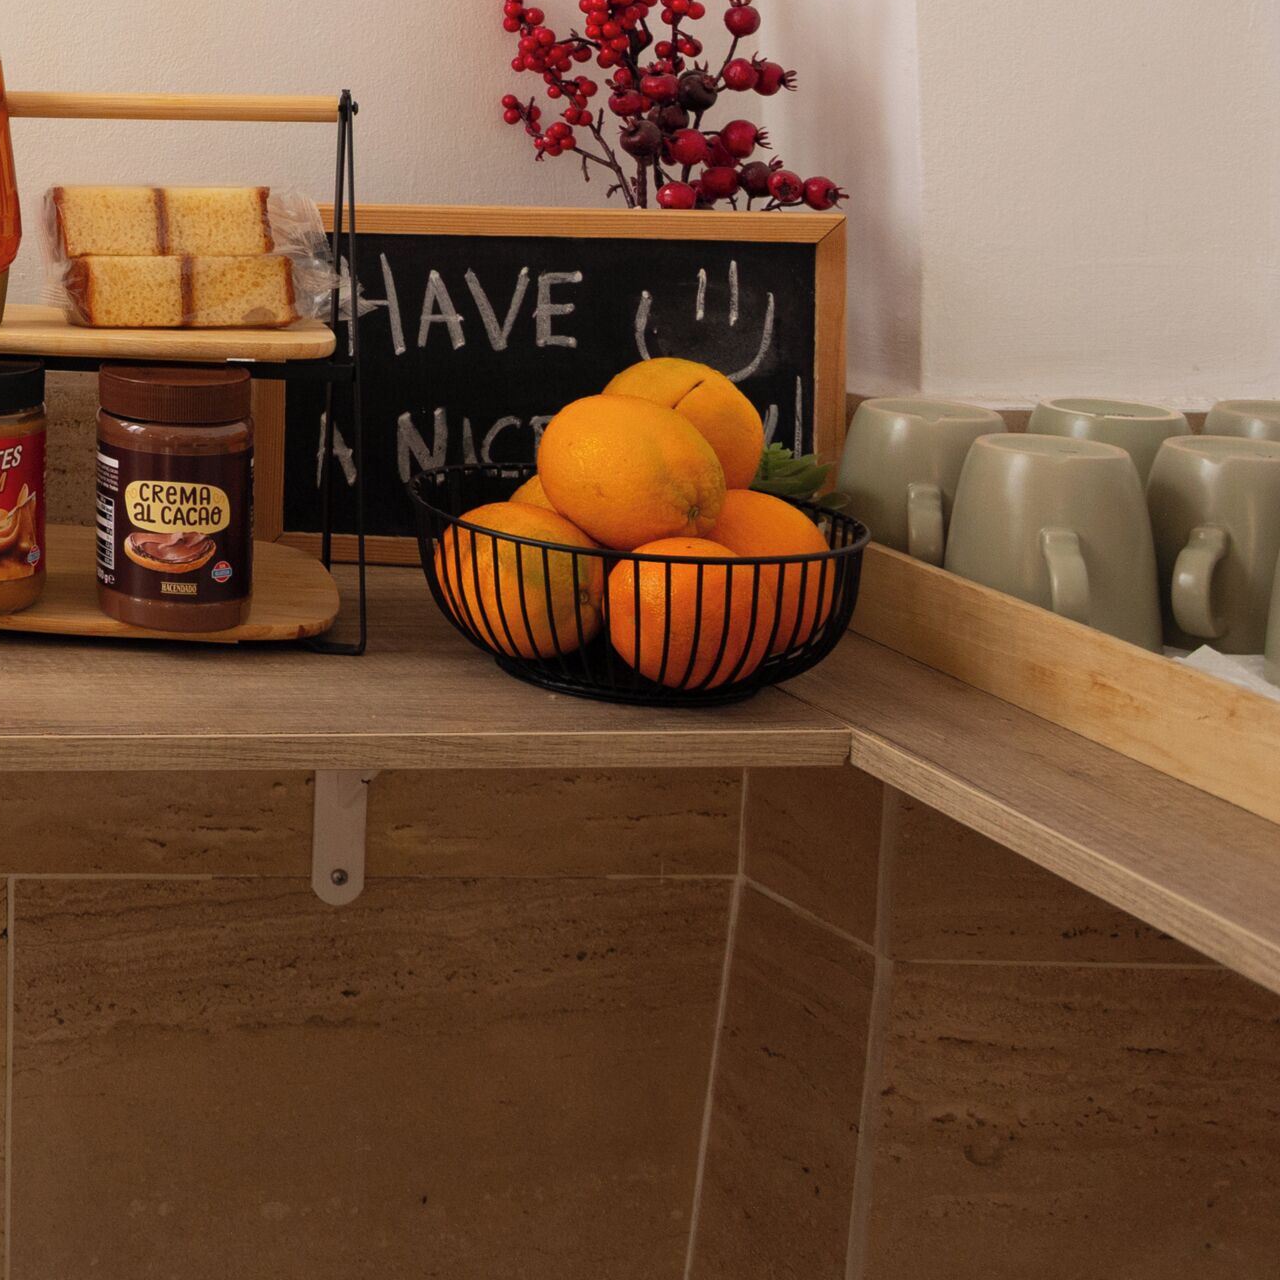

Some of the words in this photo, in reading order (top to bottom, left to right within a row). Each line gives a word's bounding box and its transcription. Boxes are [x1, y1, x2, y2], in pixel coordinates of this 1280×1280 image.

[340, 252, 584, 357] HAVE
[160, 506, 223, 526] CACAO
[161, 582, 198, 594] HACENDADO
